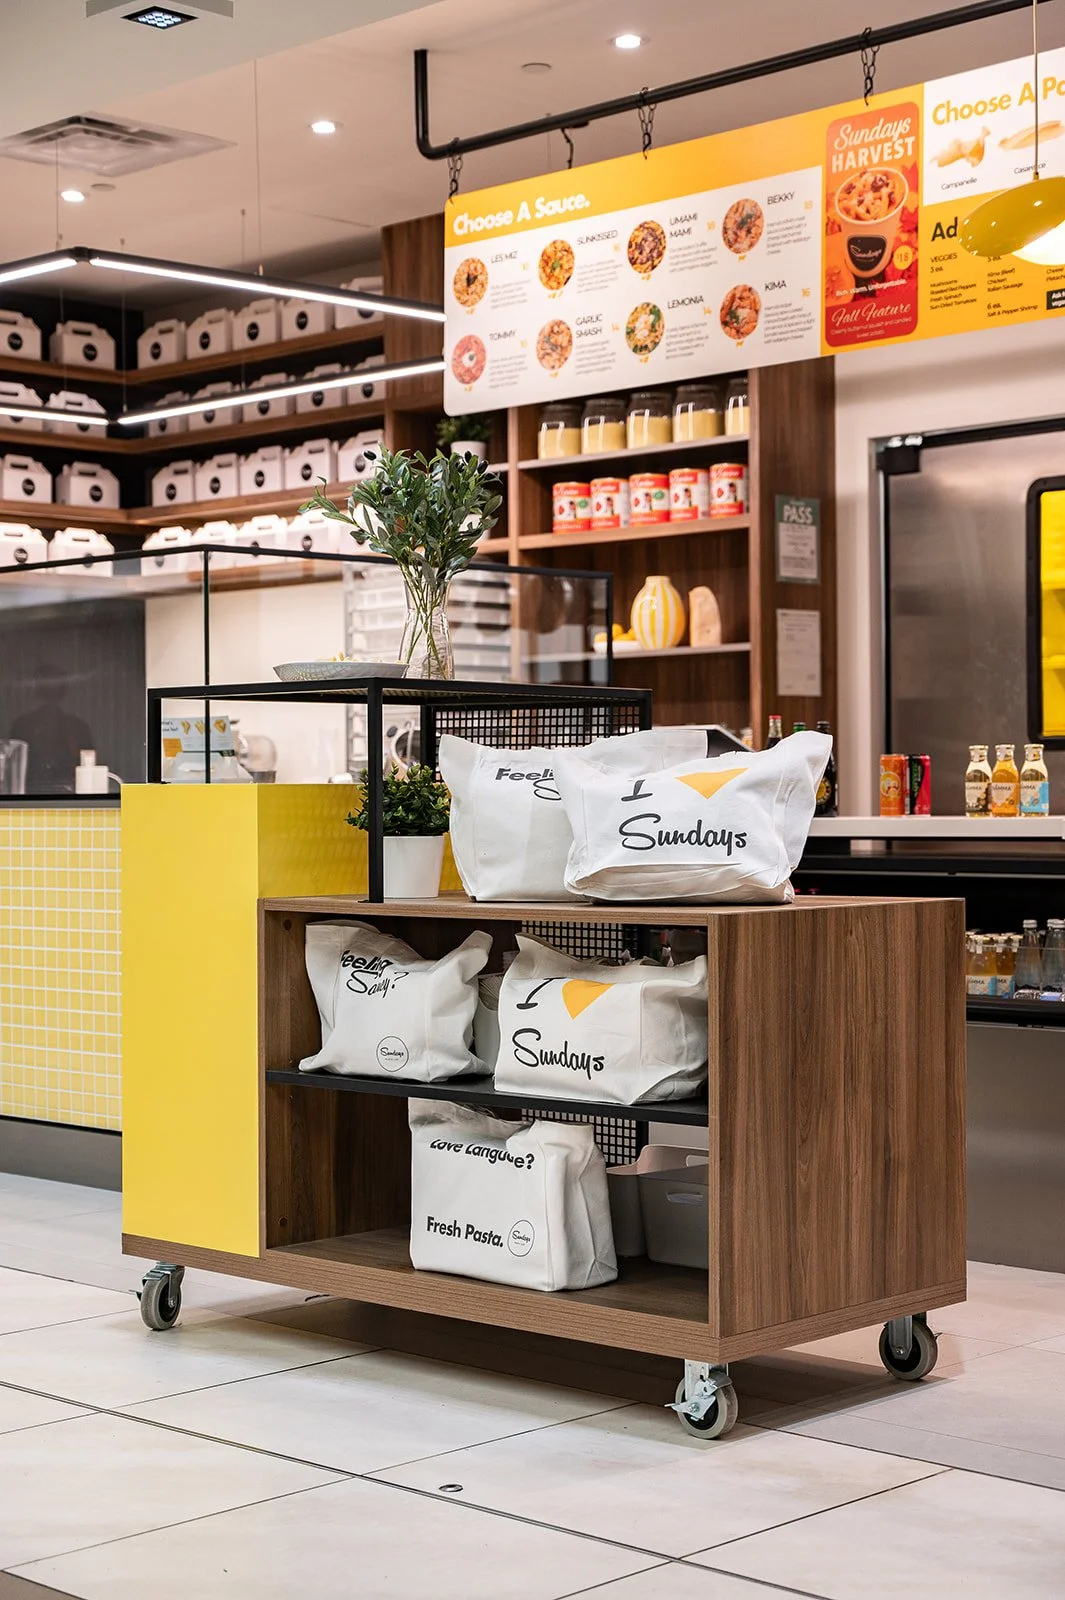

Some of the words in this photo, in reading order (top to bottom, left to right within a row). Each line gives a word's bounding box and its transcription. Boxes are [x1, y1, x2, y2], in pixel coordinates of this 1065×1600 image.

[932, 94, 1012, 125] Choose
[1018, 82, 1036, 106] A
[833, 117, 912, 151] Sundays
[831, 136, 916, 174] HARVEST
[453, 210, 514, 235] Choose
[516, 201, 531, 222] A
[534, 193, 591, 218] Sauce.
[767, 191, 796, 206] BEKKY
[669, 212, 698, 226] UMAMI
[764, 279, 787, 292] KIMA
[666, 295, 705, 310] LEMONIA
[831, 307, 861, 327] Fall
[861, 302, 911, 322] Feature
[783, 504, 813, 525] PASS
[618, 813, 747, 856] Sundays
[380, 1046, 404, 1058] Sundays
[511, 1027, 605, 1080] Sundays
[430, 1139, 464, 1153] Love
[465, 1143, 535, 1170] Langue?
[426, 1215, 461, 1239] Fresh
[465, 1223, 504, 1248] Pasta.
